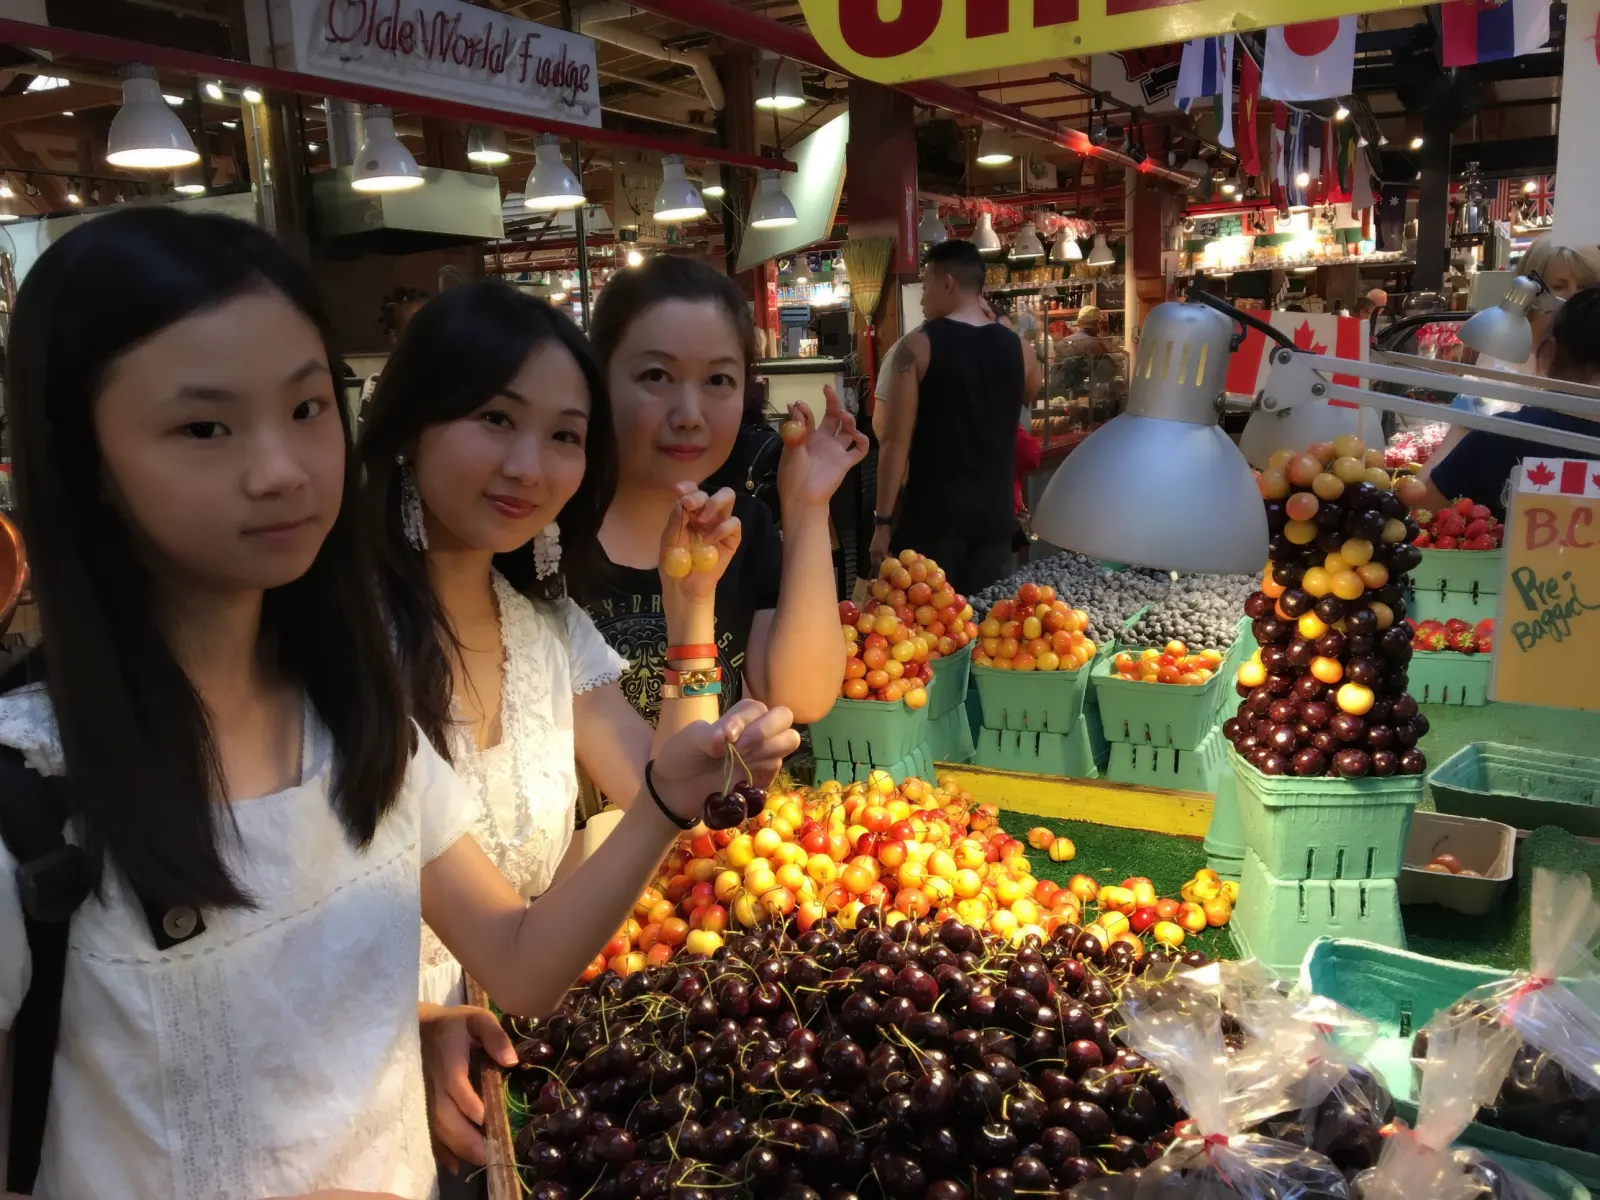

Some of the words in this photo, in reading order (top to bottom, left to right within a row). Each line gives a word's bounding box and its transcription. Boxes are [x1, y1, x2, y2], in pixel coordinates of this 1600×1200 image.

[327, 0, 415, 54] Olde
[417, 9, 510, 75] World
[518, 32, 590, 107] Fudge
